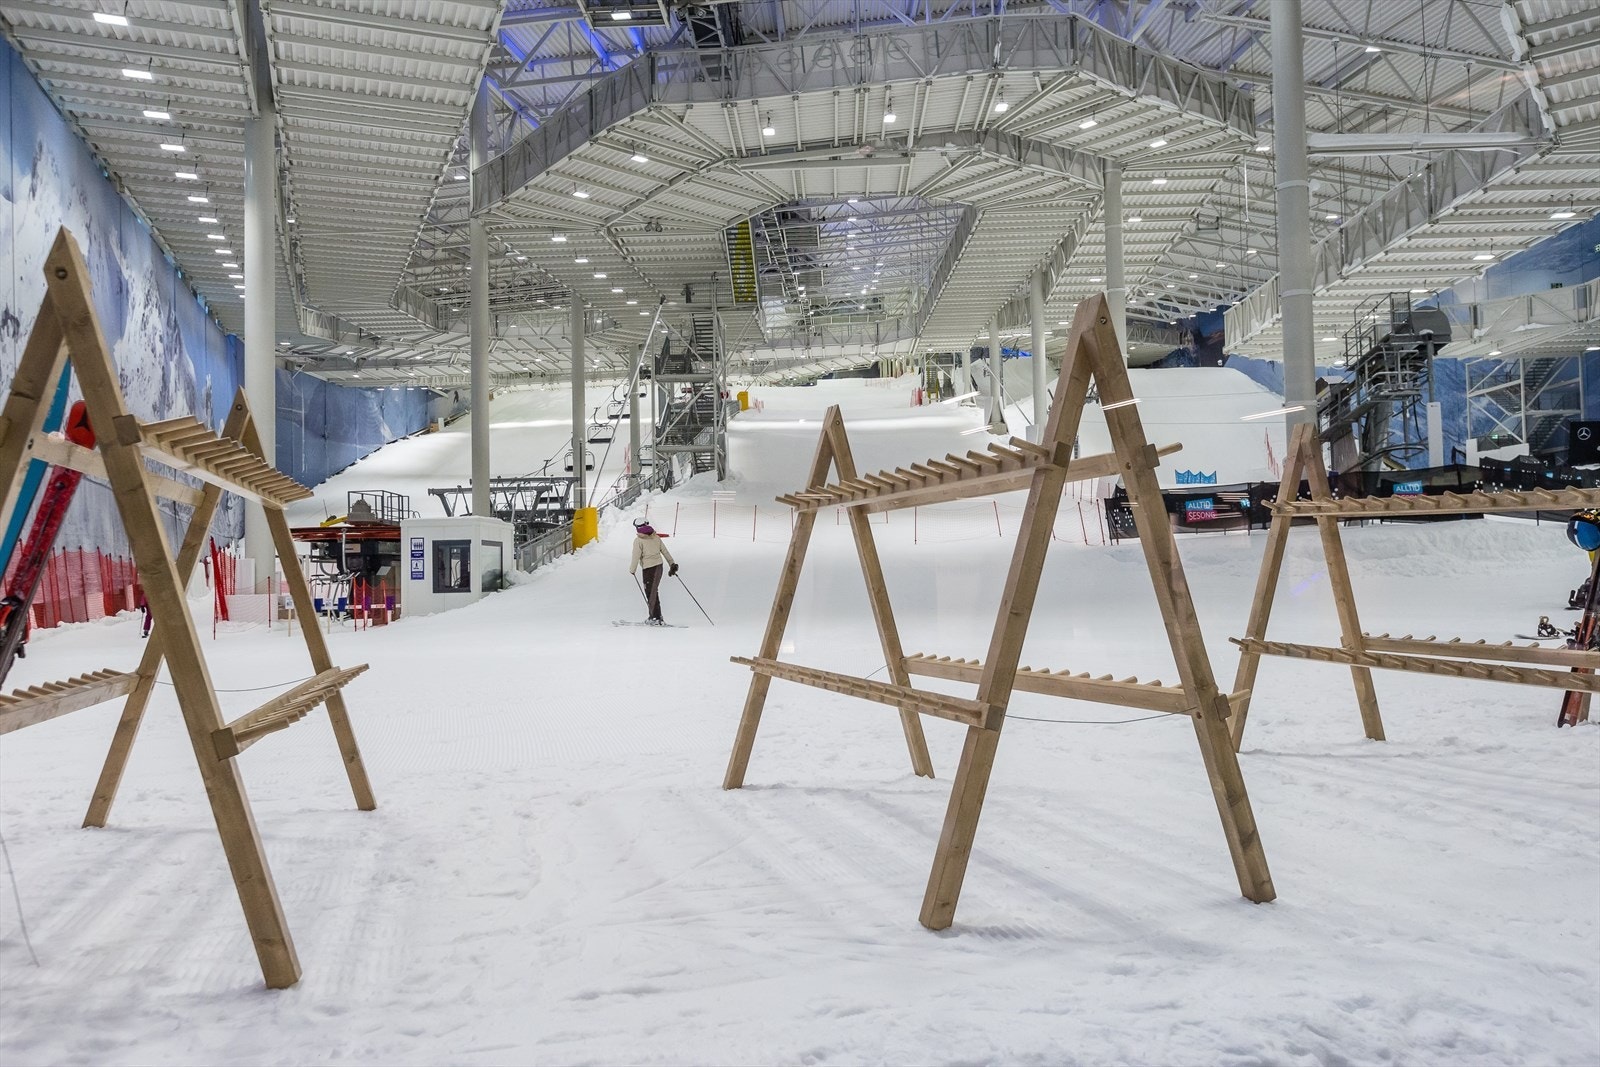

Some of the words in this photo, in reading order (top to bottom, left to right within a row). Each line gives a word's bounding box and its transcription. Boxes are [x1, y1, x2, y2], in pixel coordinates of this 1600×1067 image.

[1395, 483, 1420, 491] ALLTID
[1187, 500, 1211, 509] ALLTID
[1188, 511, 1216, 520] SESONG
